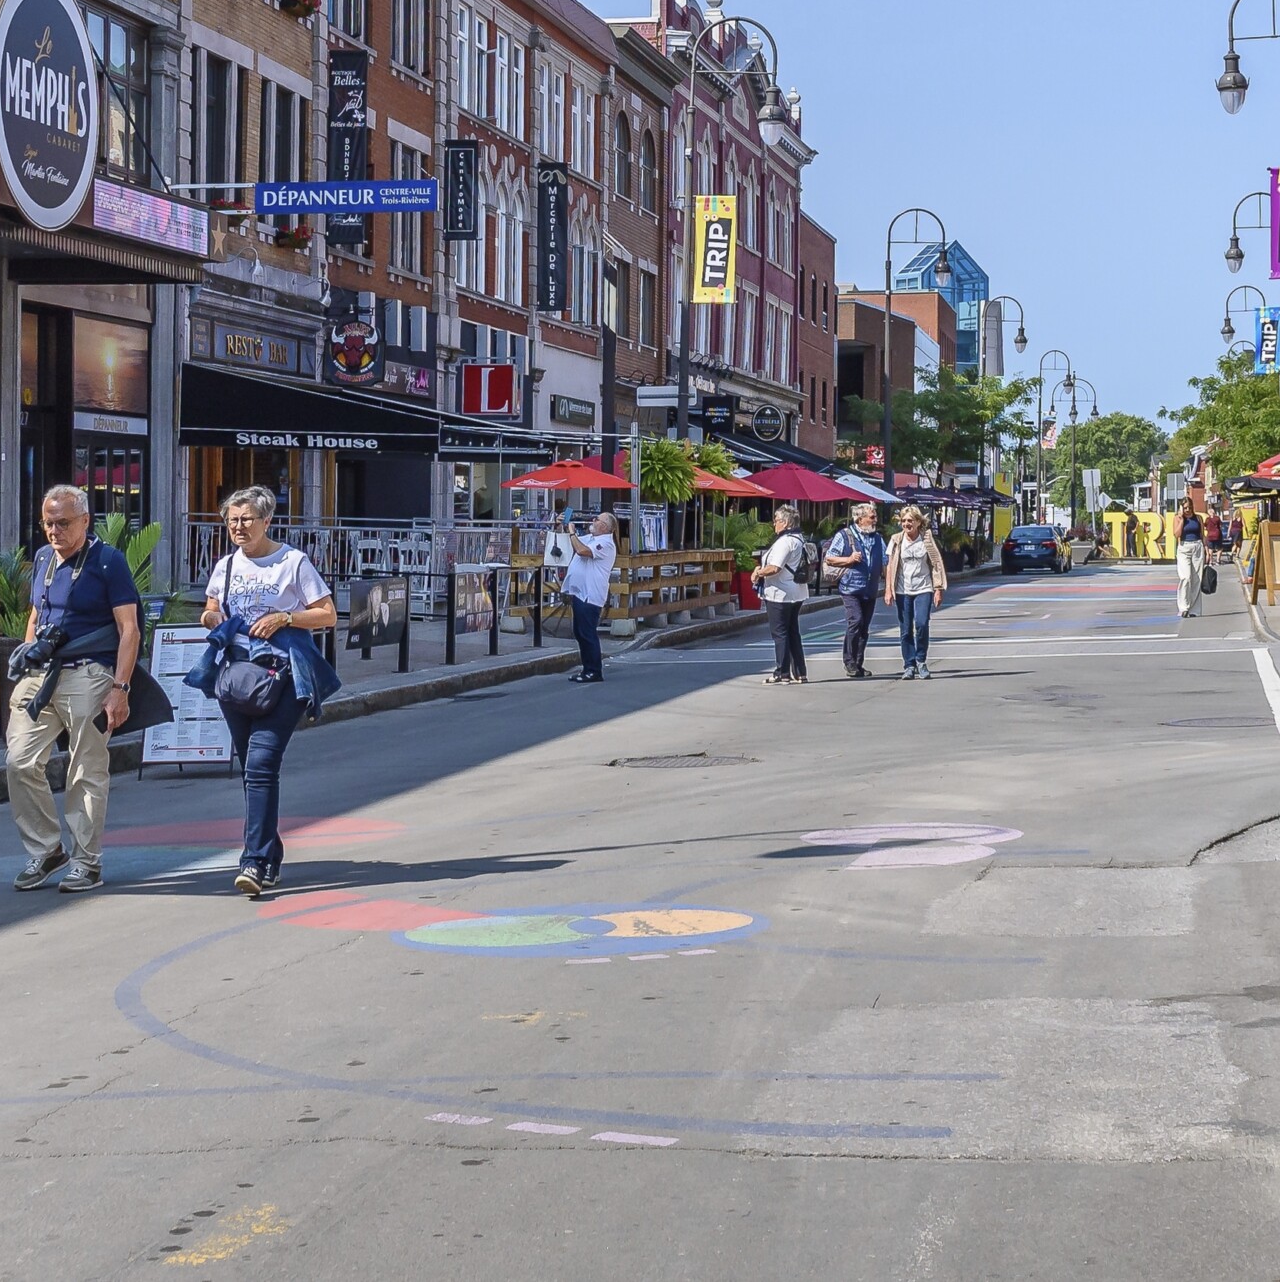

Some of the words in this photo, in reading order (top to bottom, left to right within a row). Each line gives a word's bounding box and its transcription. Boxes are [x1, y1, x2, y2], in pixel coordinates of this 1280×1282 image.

[333, 75, 361, 86] Belles
[4, 51, 88, 138] MEMPHIS
[46, 132, 81, 153] CABARET
[263, 185, 375, 207] DÉPANNEUR
[379, 187, 432, 196] CENTRE-VILLE
[380, 195, 431, 206] Trois-Rivières
[548, 186, 558, 249] Mercerie
[549, 253, 557, 270] De
[704, 222, 729, 283] TRIP
[549, 275, 557, 307] Luxe
[1261, 322, 1278, 362] TRIP
[480, 367, 509, 413] L
[93, 414, 129, 433] DÉPANNEUR
[235, 432, 300, 448] Steak
[306, 433, 379, 449] House
